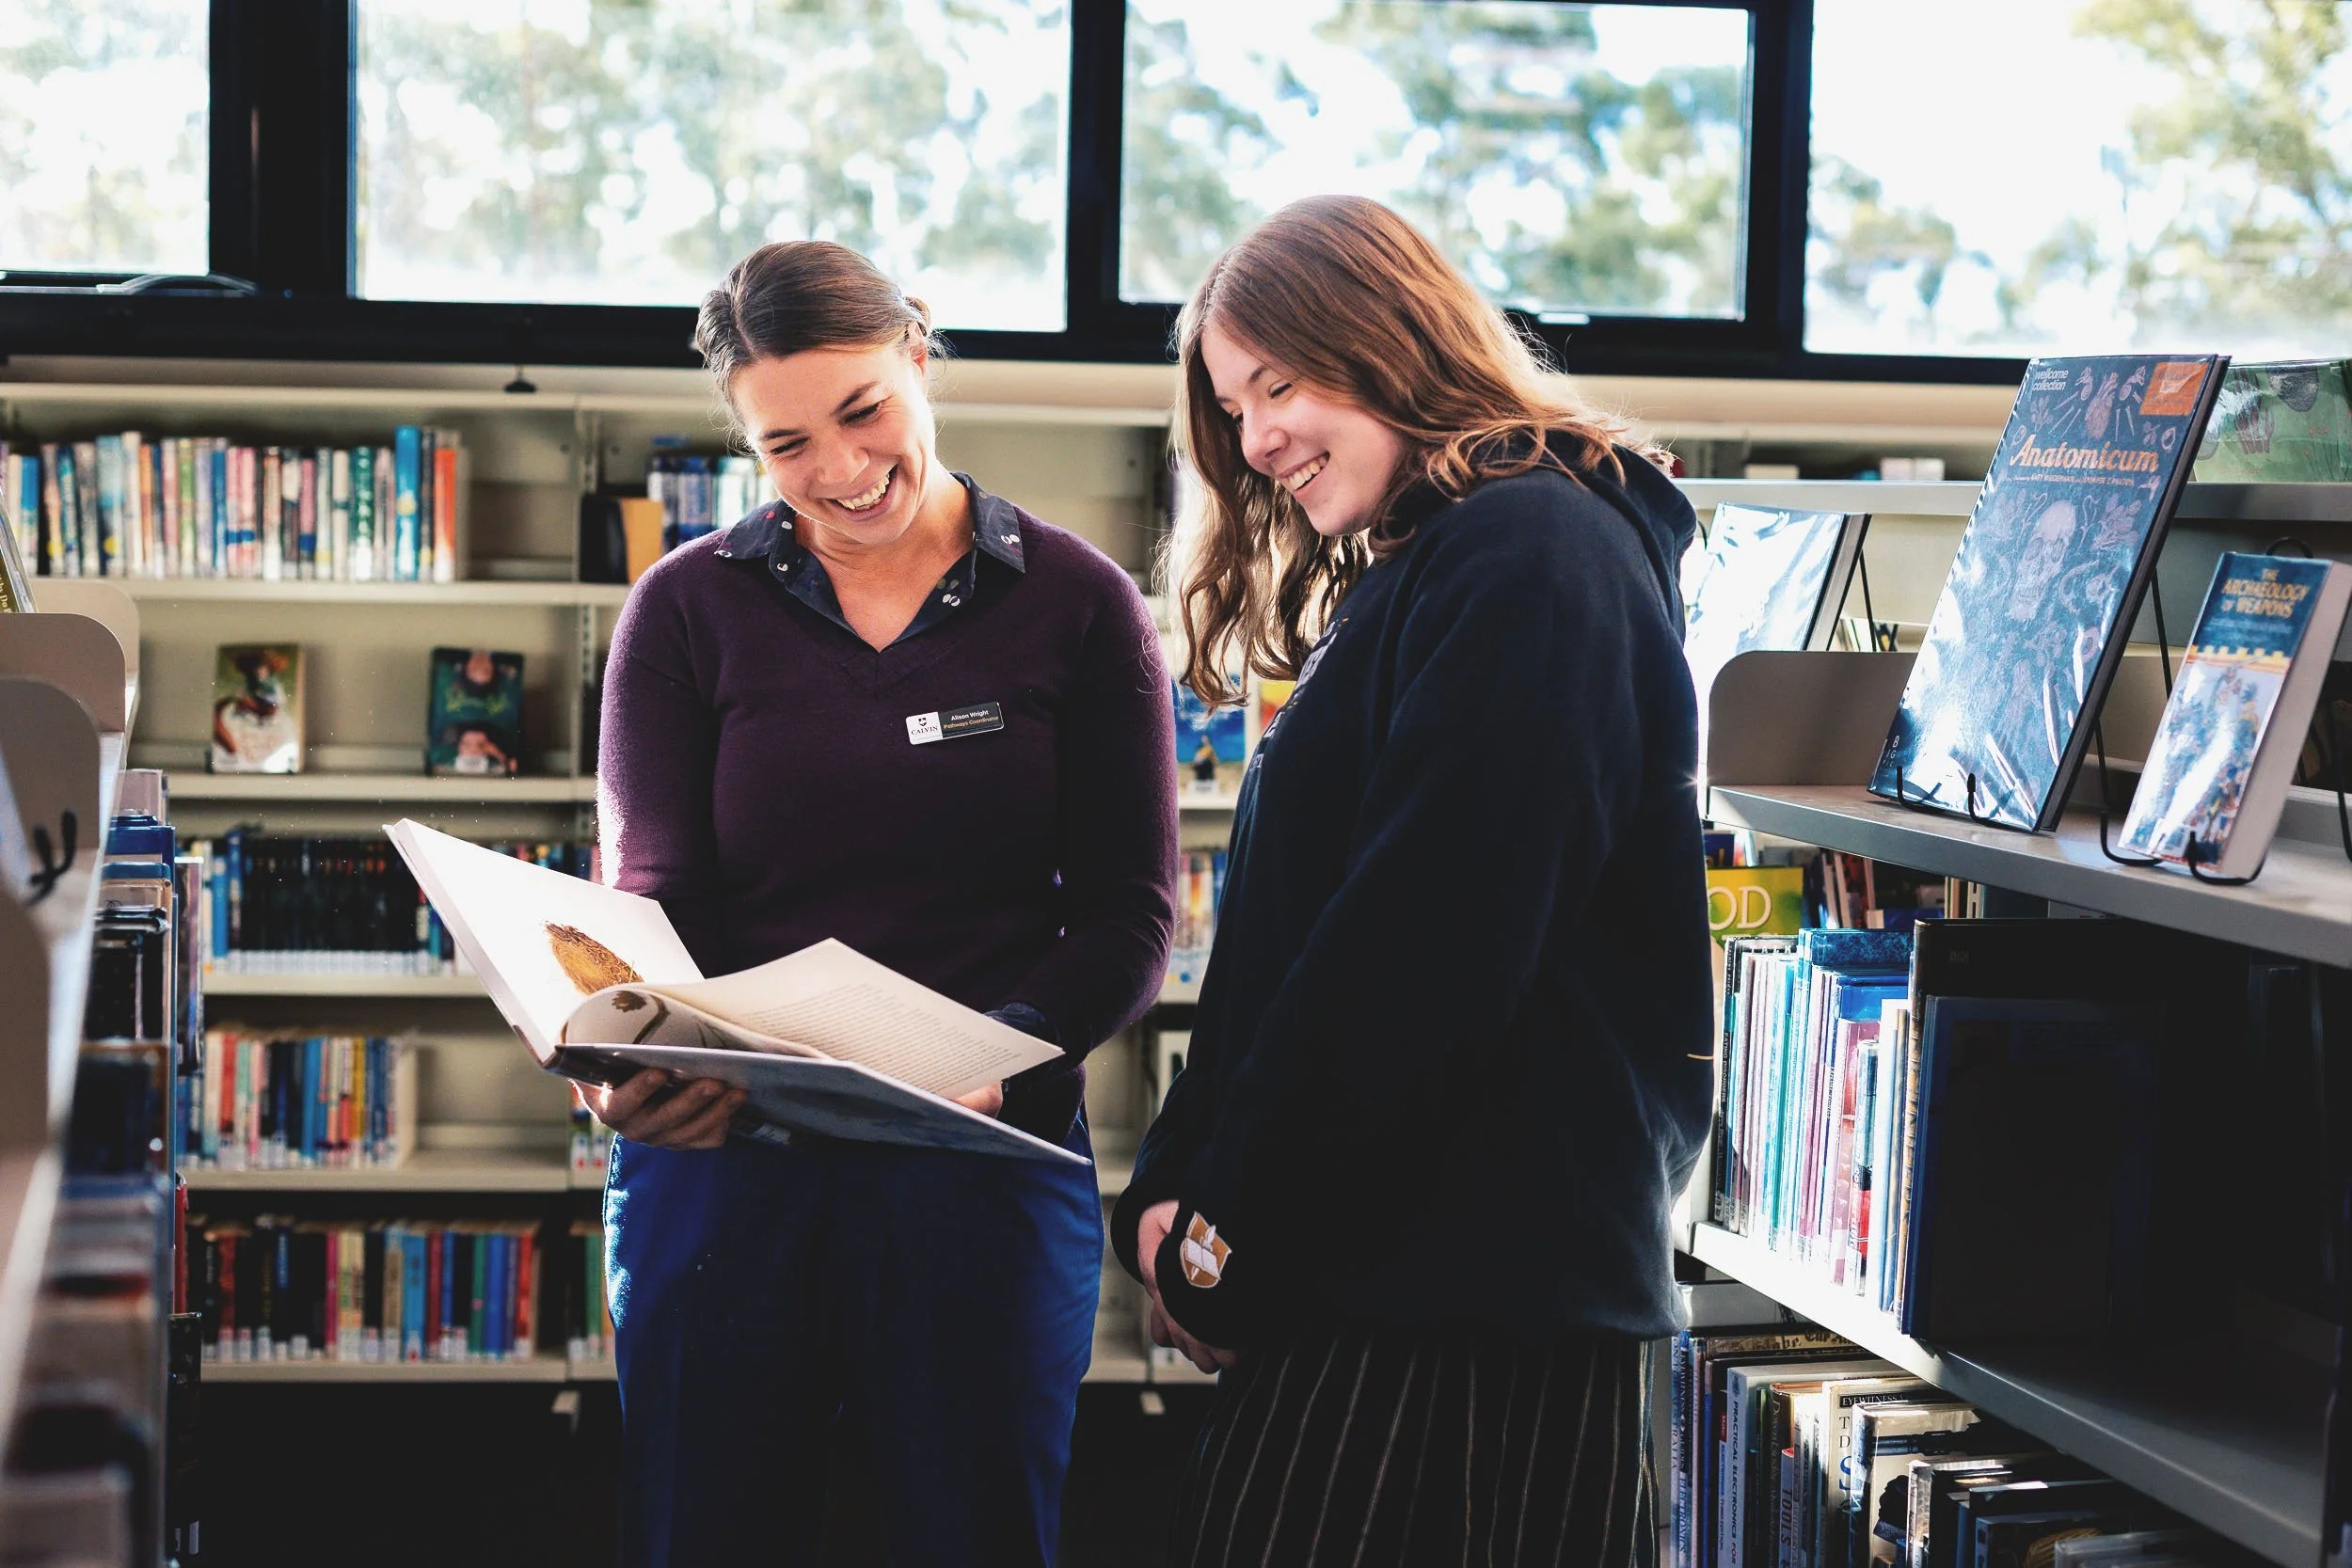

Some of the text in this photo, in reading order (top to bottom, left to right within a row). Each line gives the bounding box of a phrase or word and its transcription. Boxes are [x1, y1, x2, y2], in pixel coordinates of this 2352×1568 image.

[2035, 369, 2069, 379] wellcome
[2032, 380, 2067, 390] collection
[2009, 434, 2159, 473] Anatomicum
[2221, 578, 2310, 601] ARCHAEOLOGY
[2236, 597, 2295, 618] WEAPONS
[943, 716, 999, 730] Pathways Coordinator
[911, 725, 938, 736] CALVIN
[1842, 1395, 1898, 1406] EYEWITNESS
[1780, 1489, 1792, 1545] TOOLS
